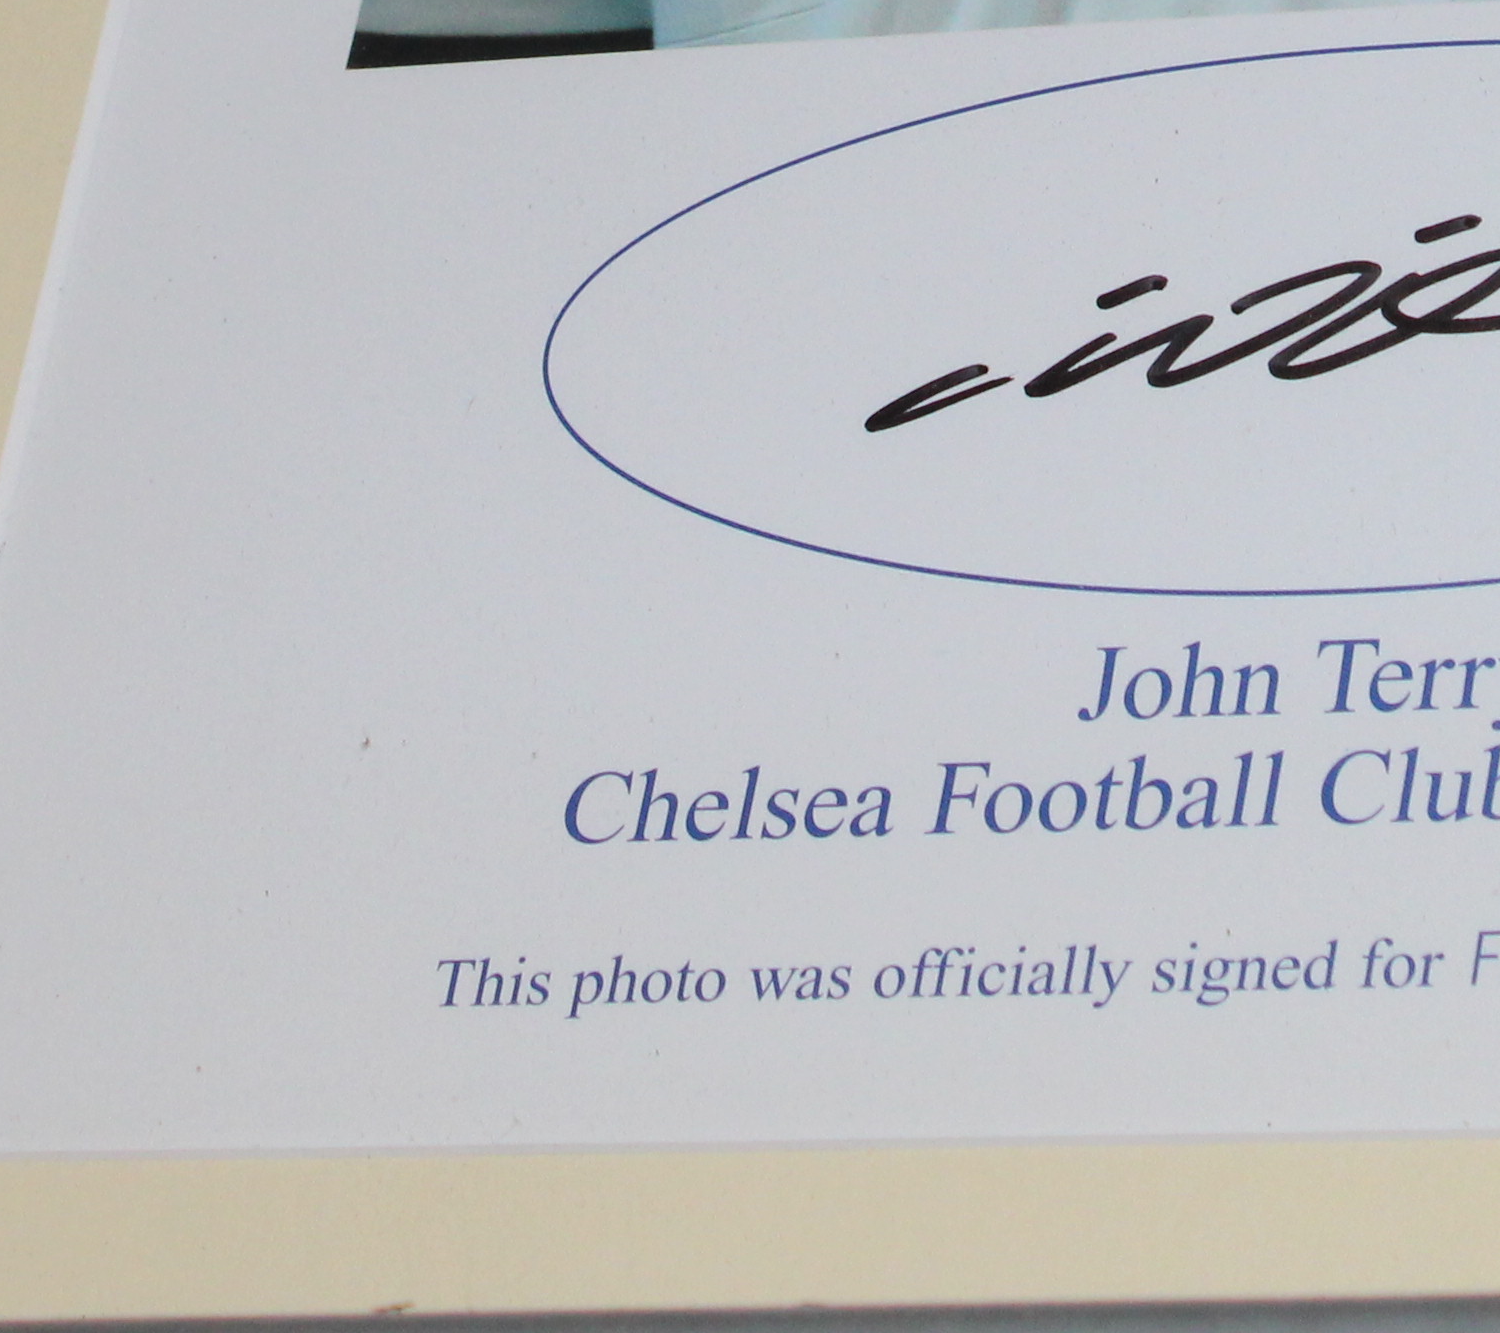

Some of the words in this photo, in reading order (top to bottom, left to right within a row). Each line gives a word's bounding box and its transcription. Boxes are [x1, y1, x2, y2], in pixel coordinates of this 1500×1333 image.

[1077, 640, 1281, 723] John
[563, 764, 894, 846] Chelsea
[923, 750, 1284, 836] Football
[436, 955, 552, 1008] This
[565, 954, 727, 1020] photo
[750, 965, 852, 1002] was
[873, 943, 1133, 1010] officially
[1151, 939, 1339, 1008] signed
[1361, 937, 1445, 990] for
